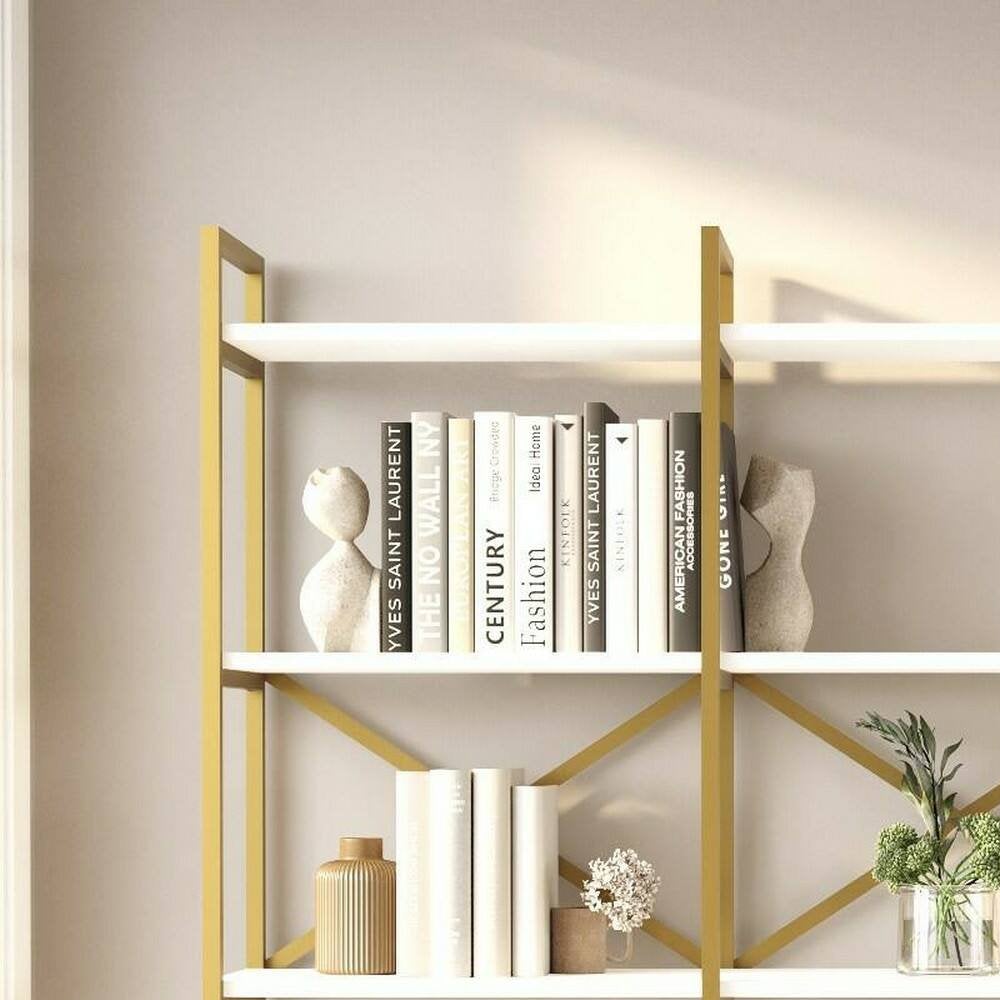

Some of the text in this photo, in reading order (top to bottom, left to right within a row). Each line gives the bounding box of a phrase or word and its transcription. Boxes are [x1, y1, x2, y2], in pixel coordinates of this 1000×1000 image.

[528, 424, 541, 492] Ideal Home
[388, 425, 402, 651] YVES SAINT LAURENT
[419, 420, 441, 640] THE NO WALL NY
[560, 499, 571, 567] KINFOLK
[587, 431, 600, 625] YVES SAINT LAURENT
[674, 449, 685, 613] AMERICAN FASHION
[686, 491, 695, 571] ACCESSORIES
[719, 529, 732, 589] GONE
[486, 528, 505, 644] CENTURY
[520, 547, 546, 647] Fashion
